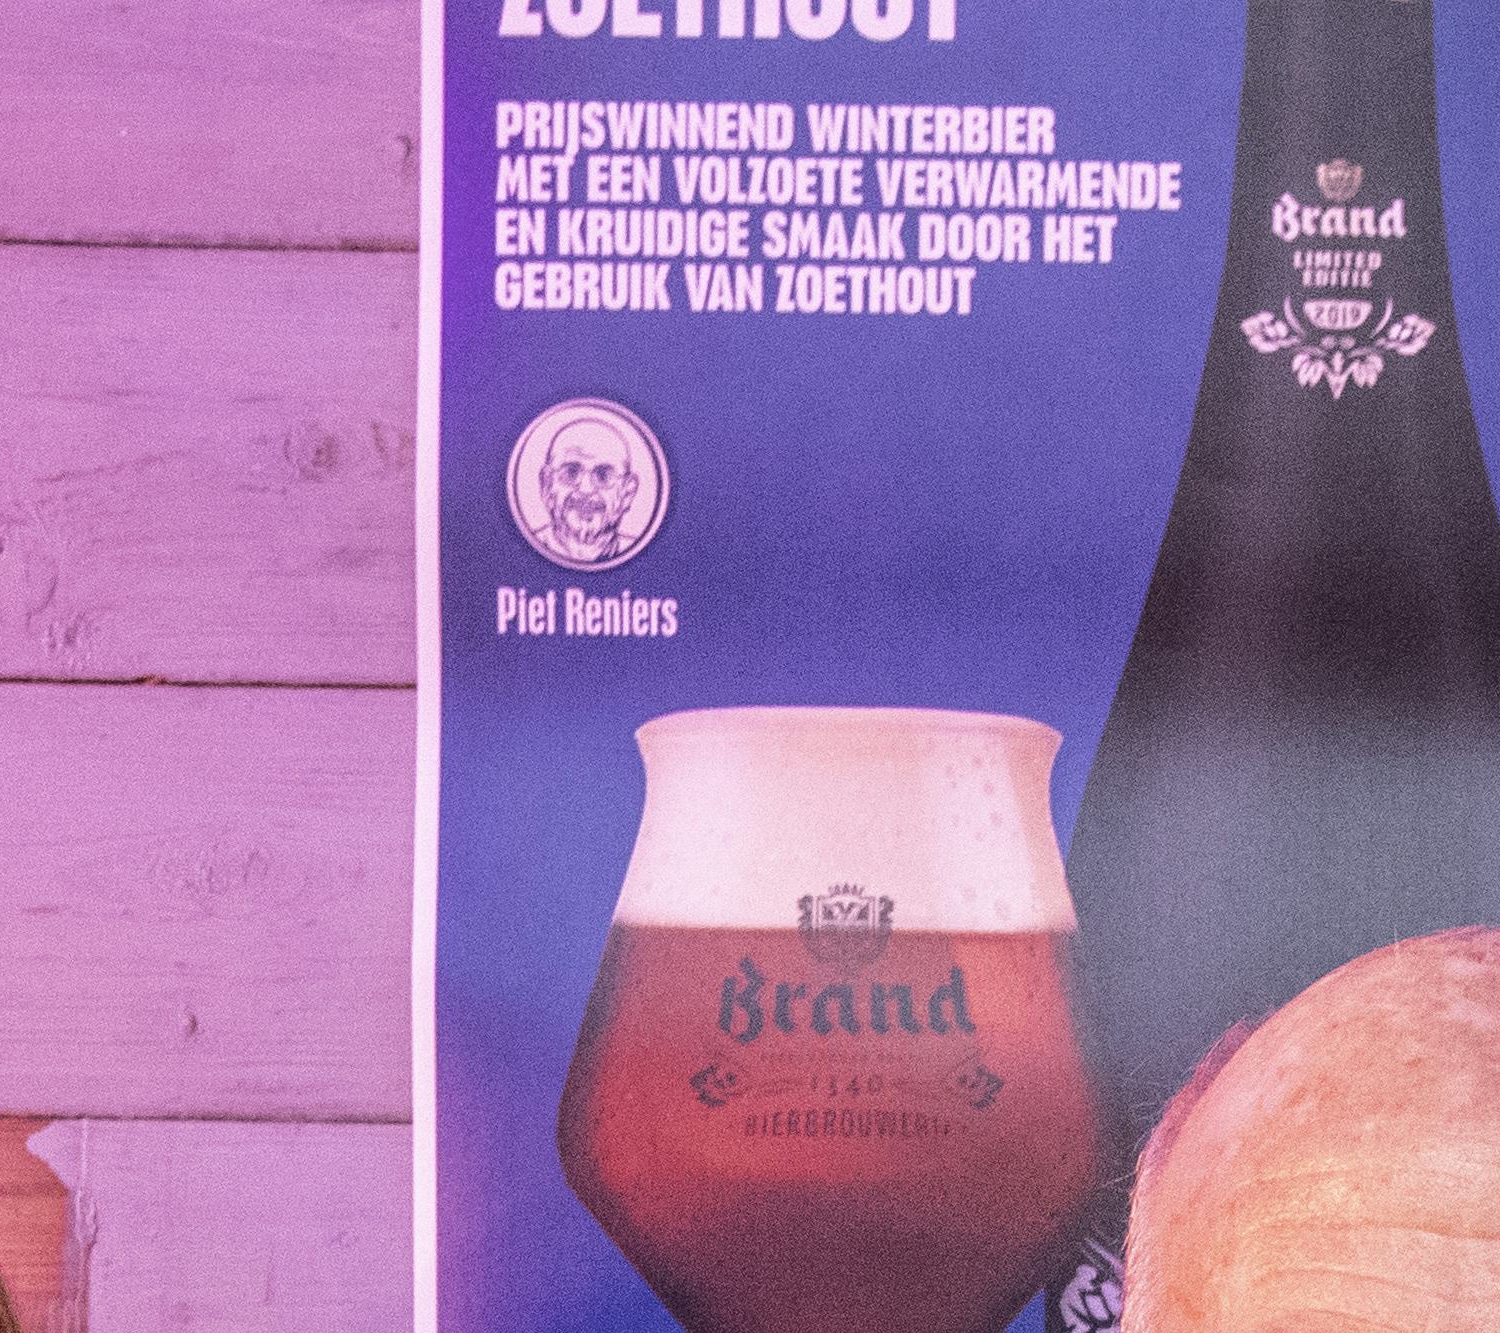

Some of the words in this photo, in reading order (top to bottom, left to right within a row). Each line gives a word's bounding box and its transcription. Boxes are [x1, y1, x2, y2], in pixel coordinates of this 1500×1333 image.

[496, 101, 794, 165] PRIJSWINNEND
[807, 103, 1056, 154] WINTERBIER
[497, 155, 574, 202] MET
[587, 155, 660, 204] EEN
[673, 156, 863, 207] VOLZOETE
[876, 158, 1182, 211] VERWARMENDE
[495, 208, 546, 256] EN
[558, 208, 750, 259] KRUIDIGE
[762, 210, 906, 260] SMAAK
[918, 212, 1031, 262] DOOR
[1043, 214, 1119, 264] HET
[1271, 192, 1407, 242] Brand
[1293, 250, 1382, 270] LIMITED
[495, 262, 671, 311] GEBRUIK
[684, 263, 763, 312] VAN
[775, 264, 977, 315] ZOETHOUT
[497, 586, 557, 635] Piet
[565, 587, 678, 637] Reniers
[717, 956, 977, 1045] Brand
